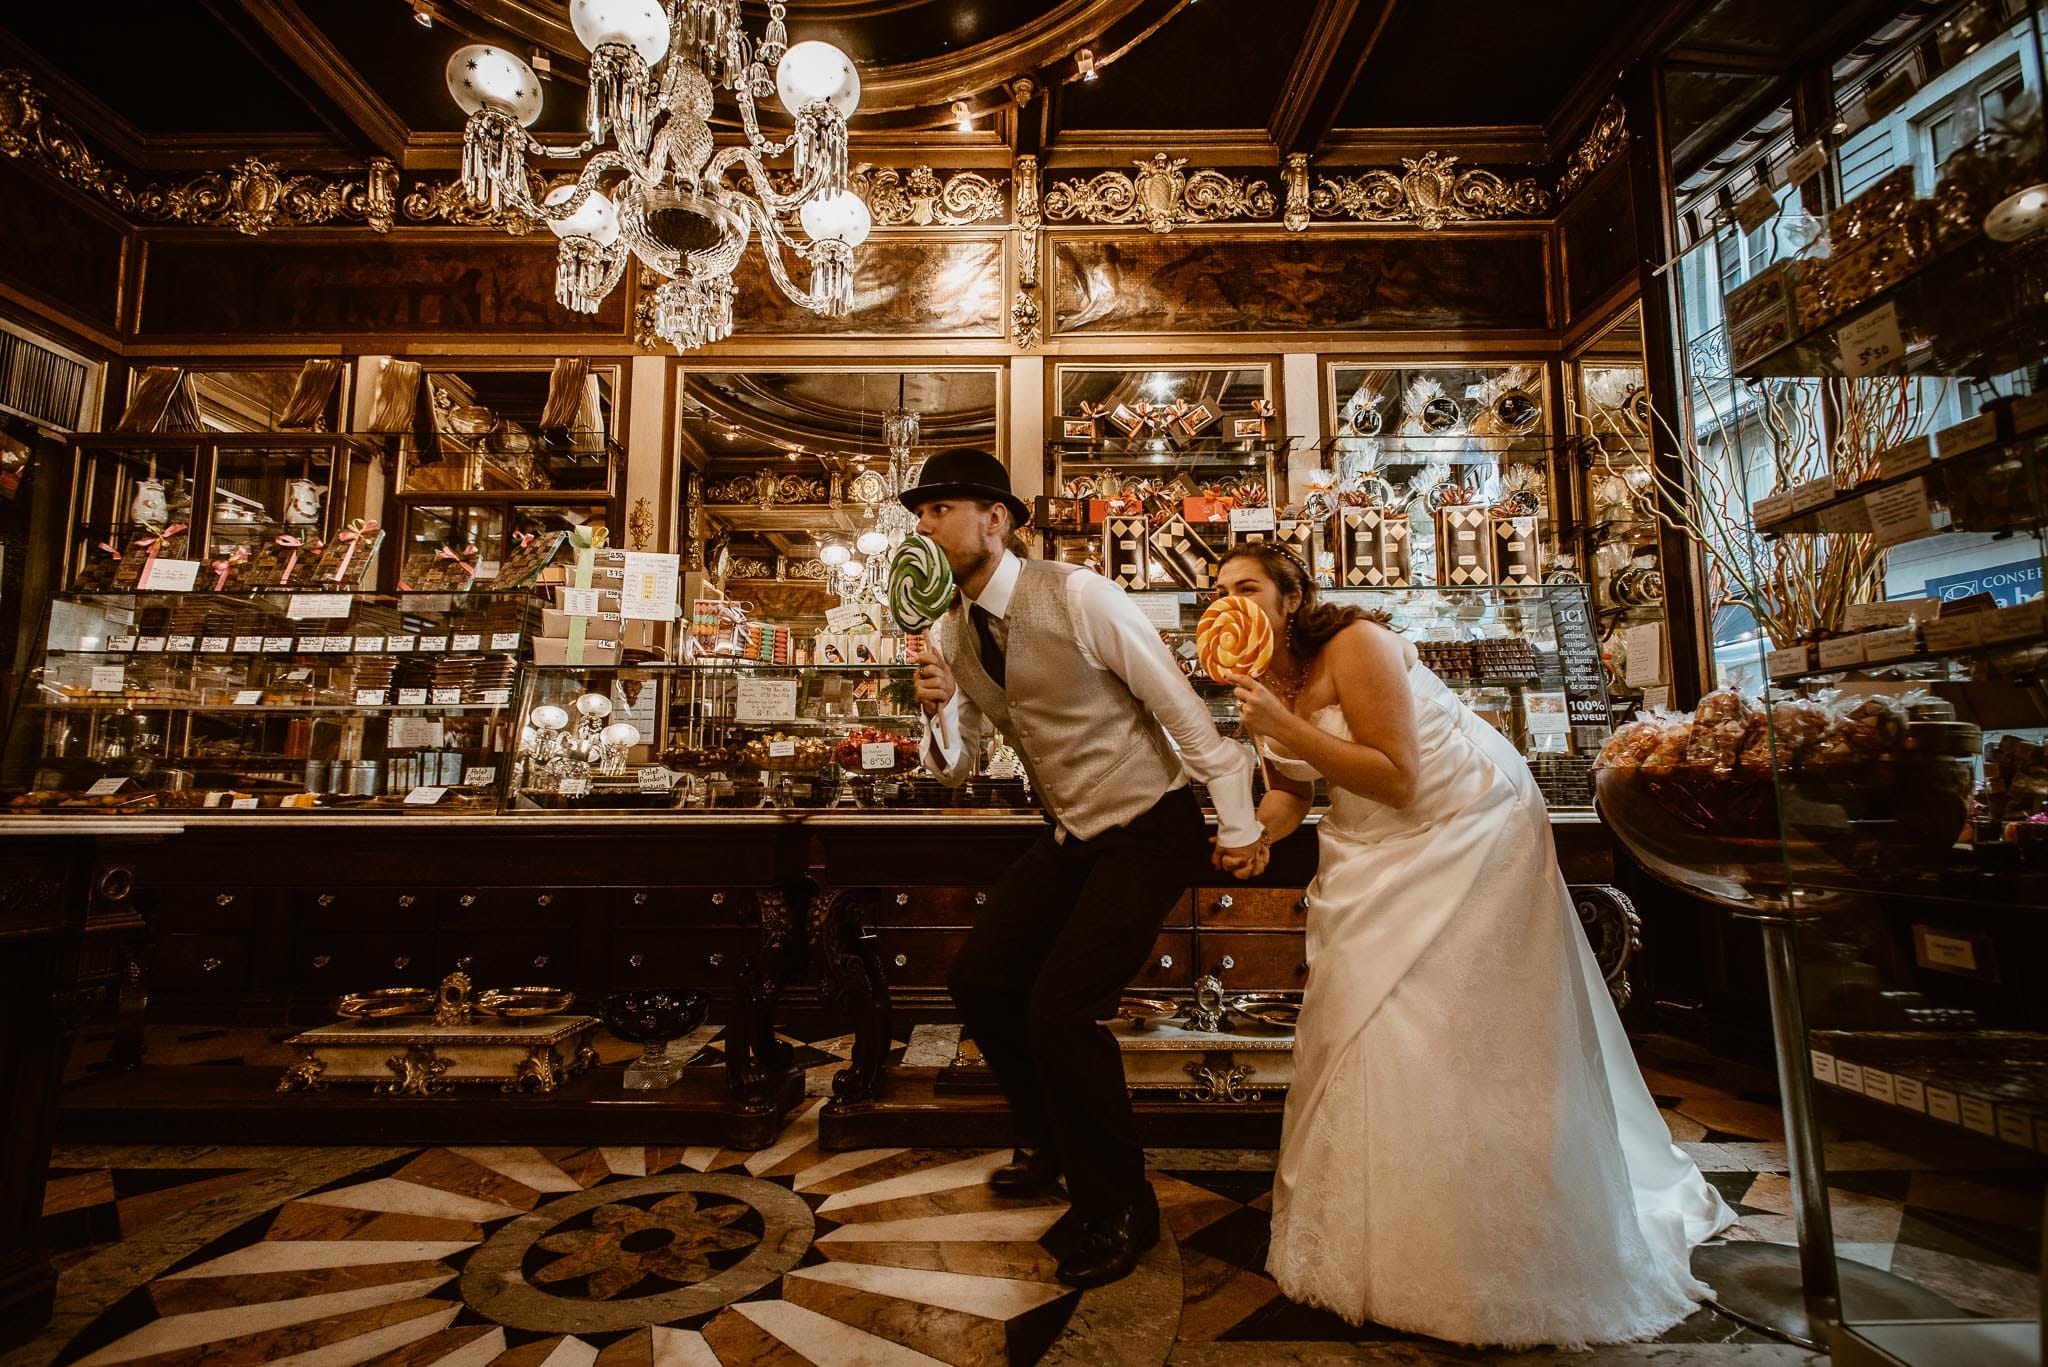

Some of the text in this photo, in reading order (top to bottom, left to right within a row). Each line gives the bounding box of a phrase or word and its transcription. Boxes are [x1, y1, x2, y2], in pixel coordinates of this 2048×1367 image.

[1560, 609, 1584, 623] ICI
[1566, 640, 1587, 648] utilise
[1570, 647, 1597, 656] chocolat
[1565, 656, 1593, 664] de haute
[1569, 664, 1593, 674] qualité
[1565, 676, 1577, 684] pur
[1570, 681, 1579, 690] de
[1569, 700, 1606, 711] 100%
[1570, 713, 1607, 721] saveur
